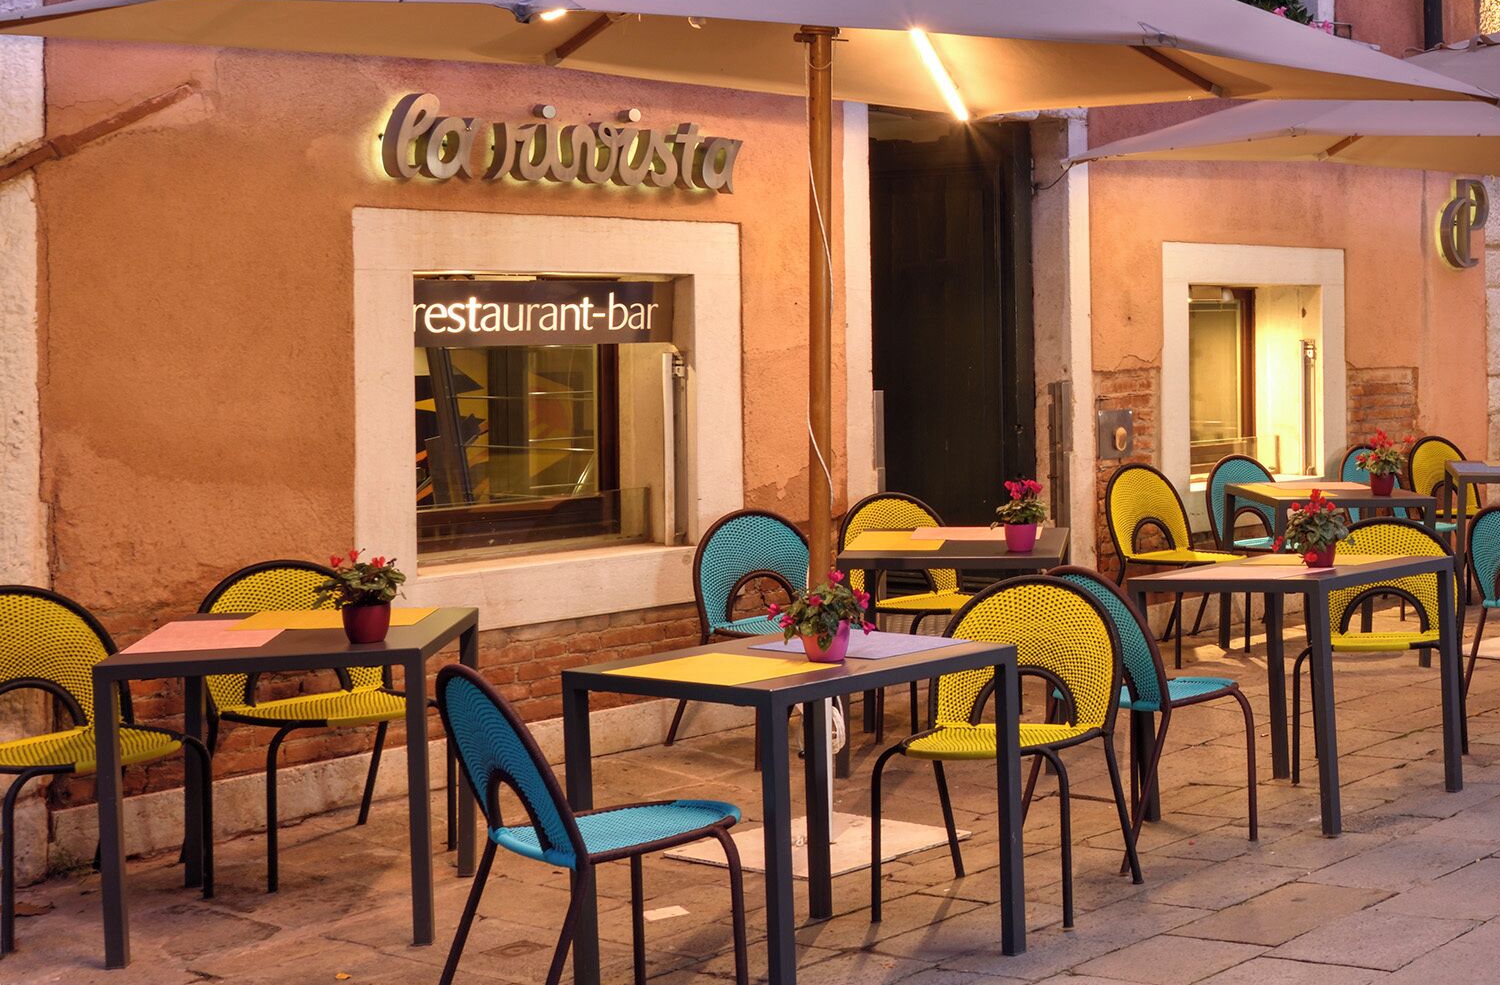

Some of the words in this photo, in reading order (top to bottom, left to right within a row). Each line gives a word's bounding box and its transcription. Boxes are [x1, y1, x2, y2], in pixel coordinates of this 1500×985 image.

[382, 93, 481, 180] la
[484, 104, 743, 195] rivista
[413, 292, 659, 333] restaurant-bar
